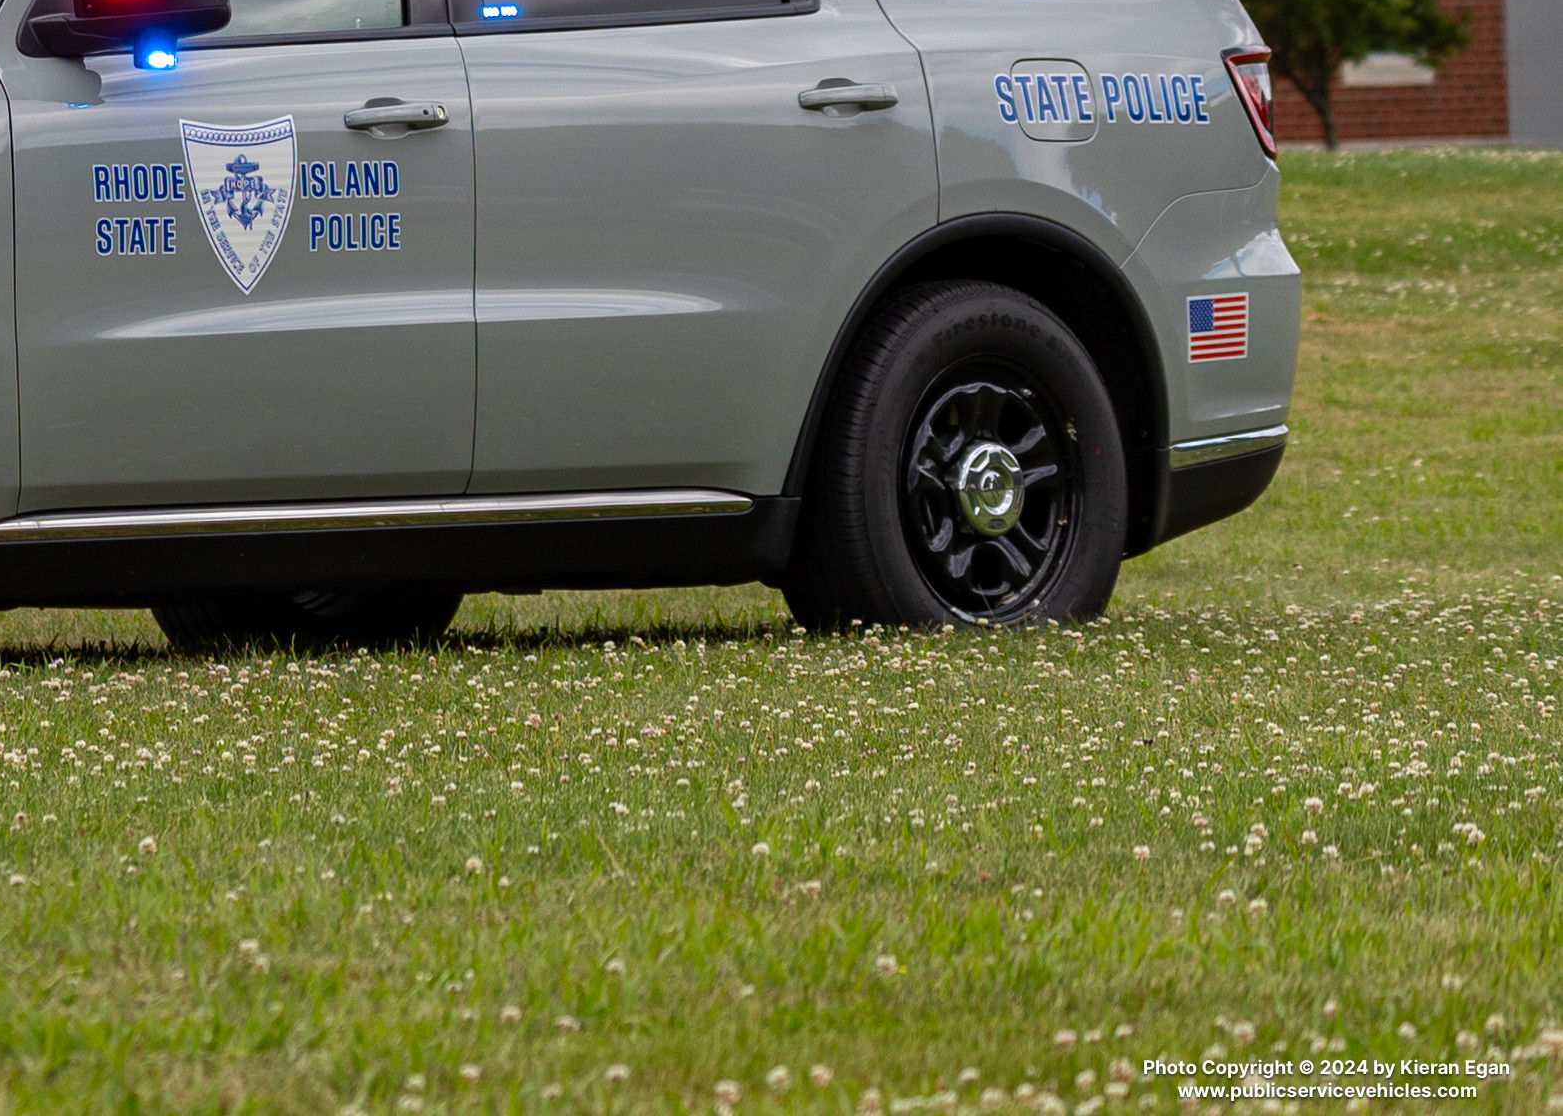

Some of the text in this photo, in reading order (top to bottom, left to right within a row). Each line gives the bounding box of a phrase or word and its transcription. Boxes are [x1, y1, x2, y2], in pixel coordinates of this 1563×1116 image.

[994, 73, 1210, 125] STATE POLICE
[93, 160, 400, 202] RHODE ISLAND
[95, 212, 401, 256] STATE POLICE
